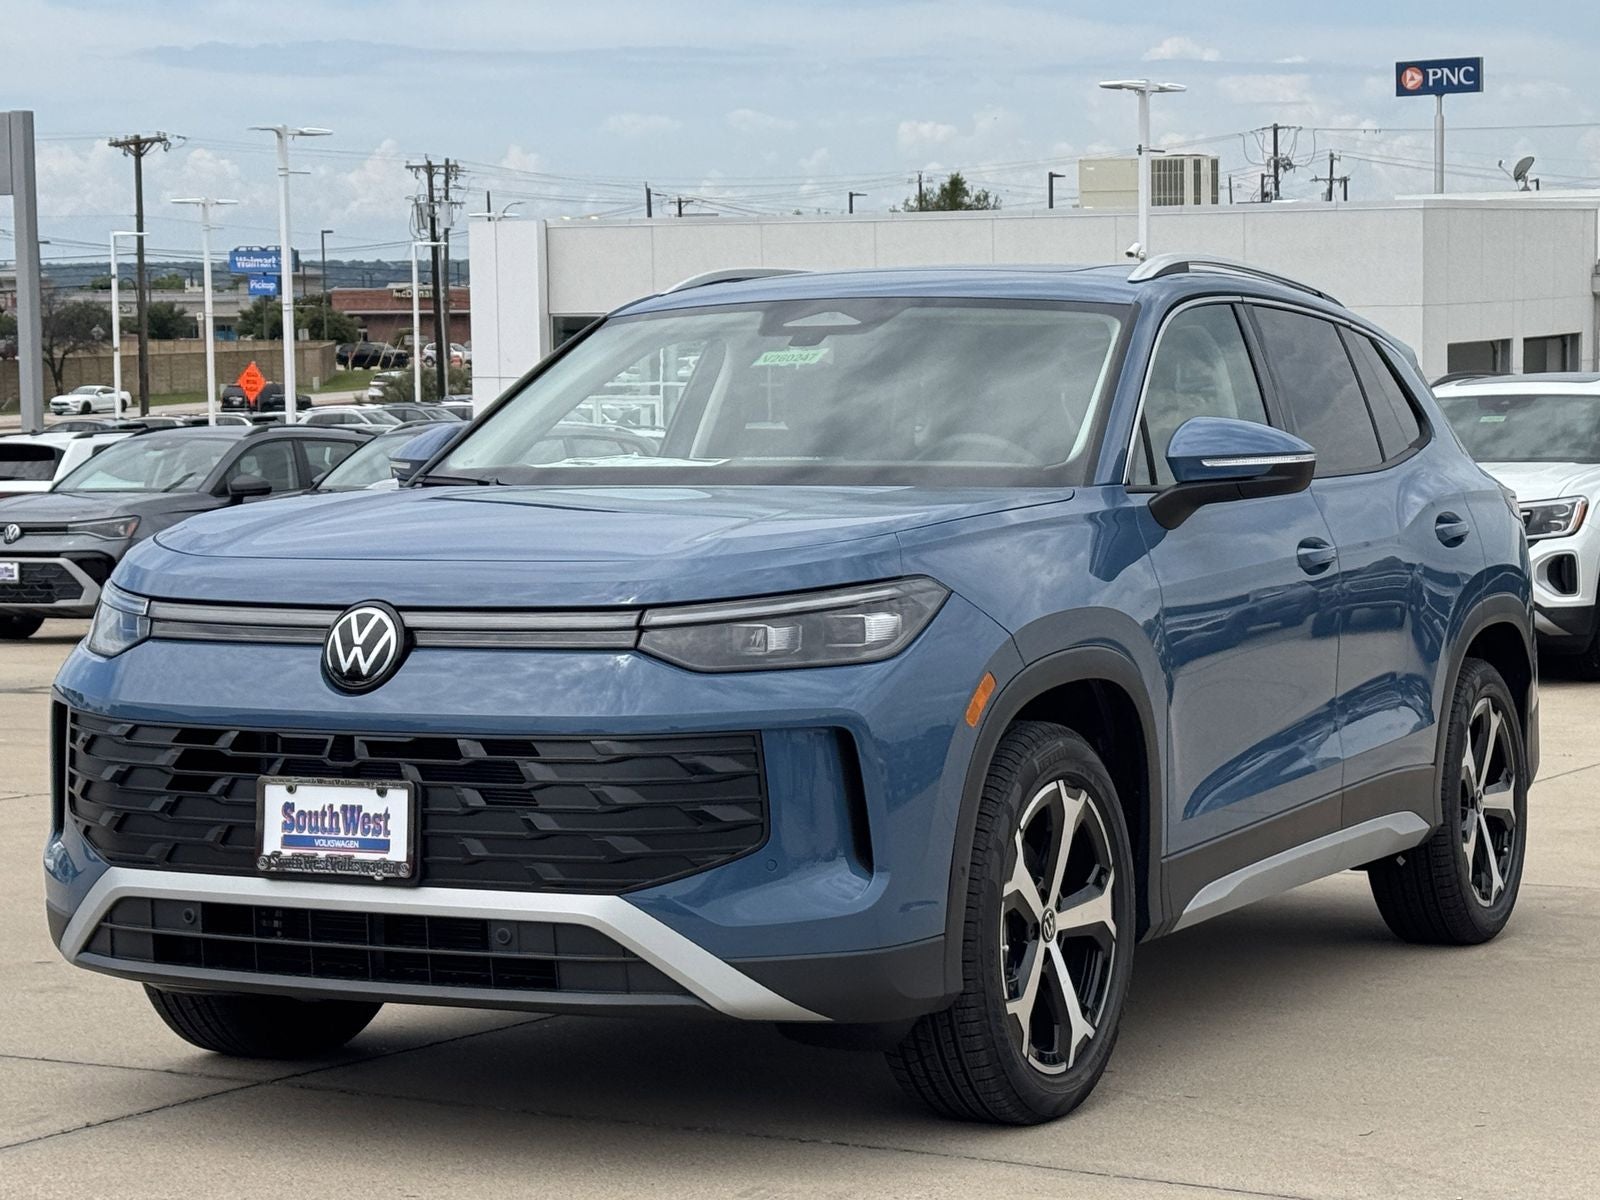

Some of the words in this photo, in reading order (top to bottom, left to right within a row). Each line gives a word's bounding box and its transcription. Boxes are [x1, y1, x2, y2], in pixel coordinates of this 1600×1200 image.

[1426, 66, 1474, 86] PNC
[235, 255, 278, 269] Walmart
[249, 279, 276, 292] Pickup
[281, 801, 391, 838] SouthWest
[314, 838, 360, 849] VOLKSWAGEN
